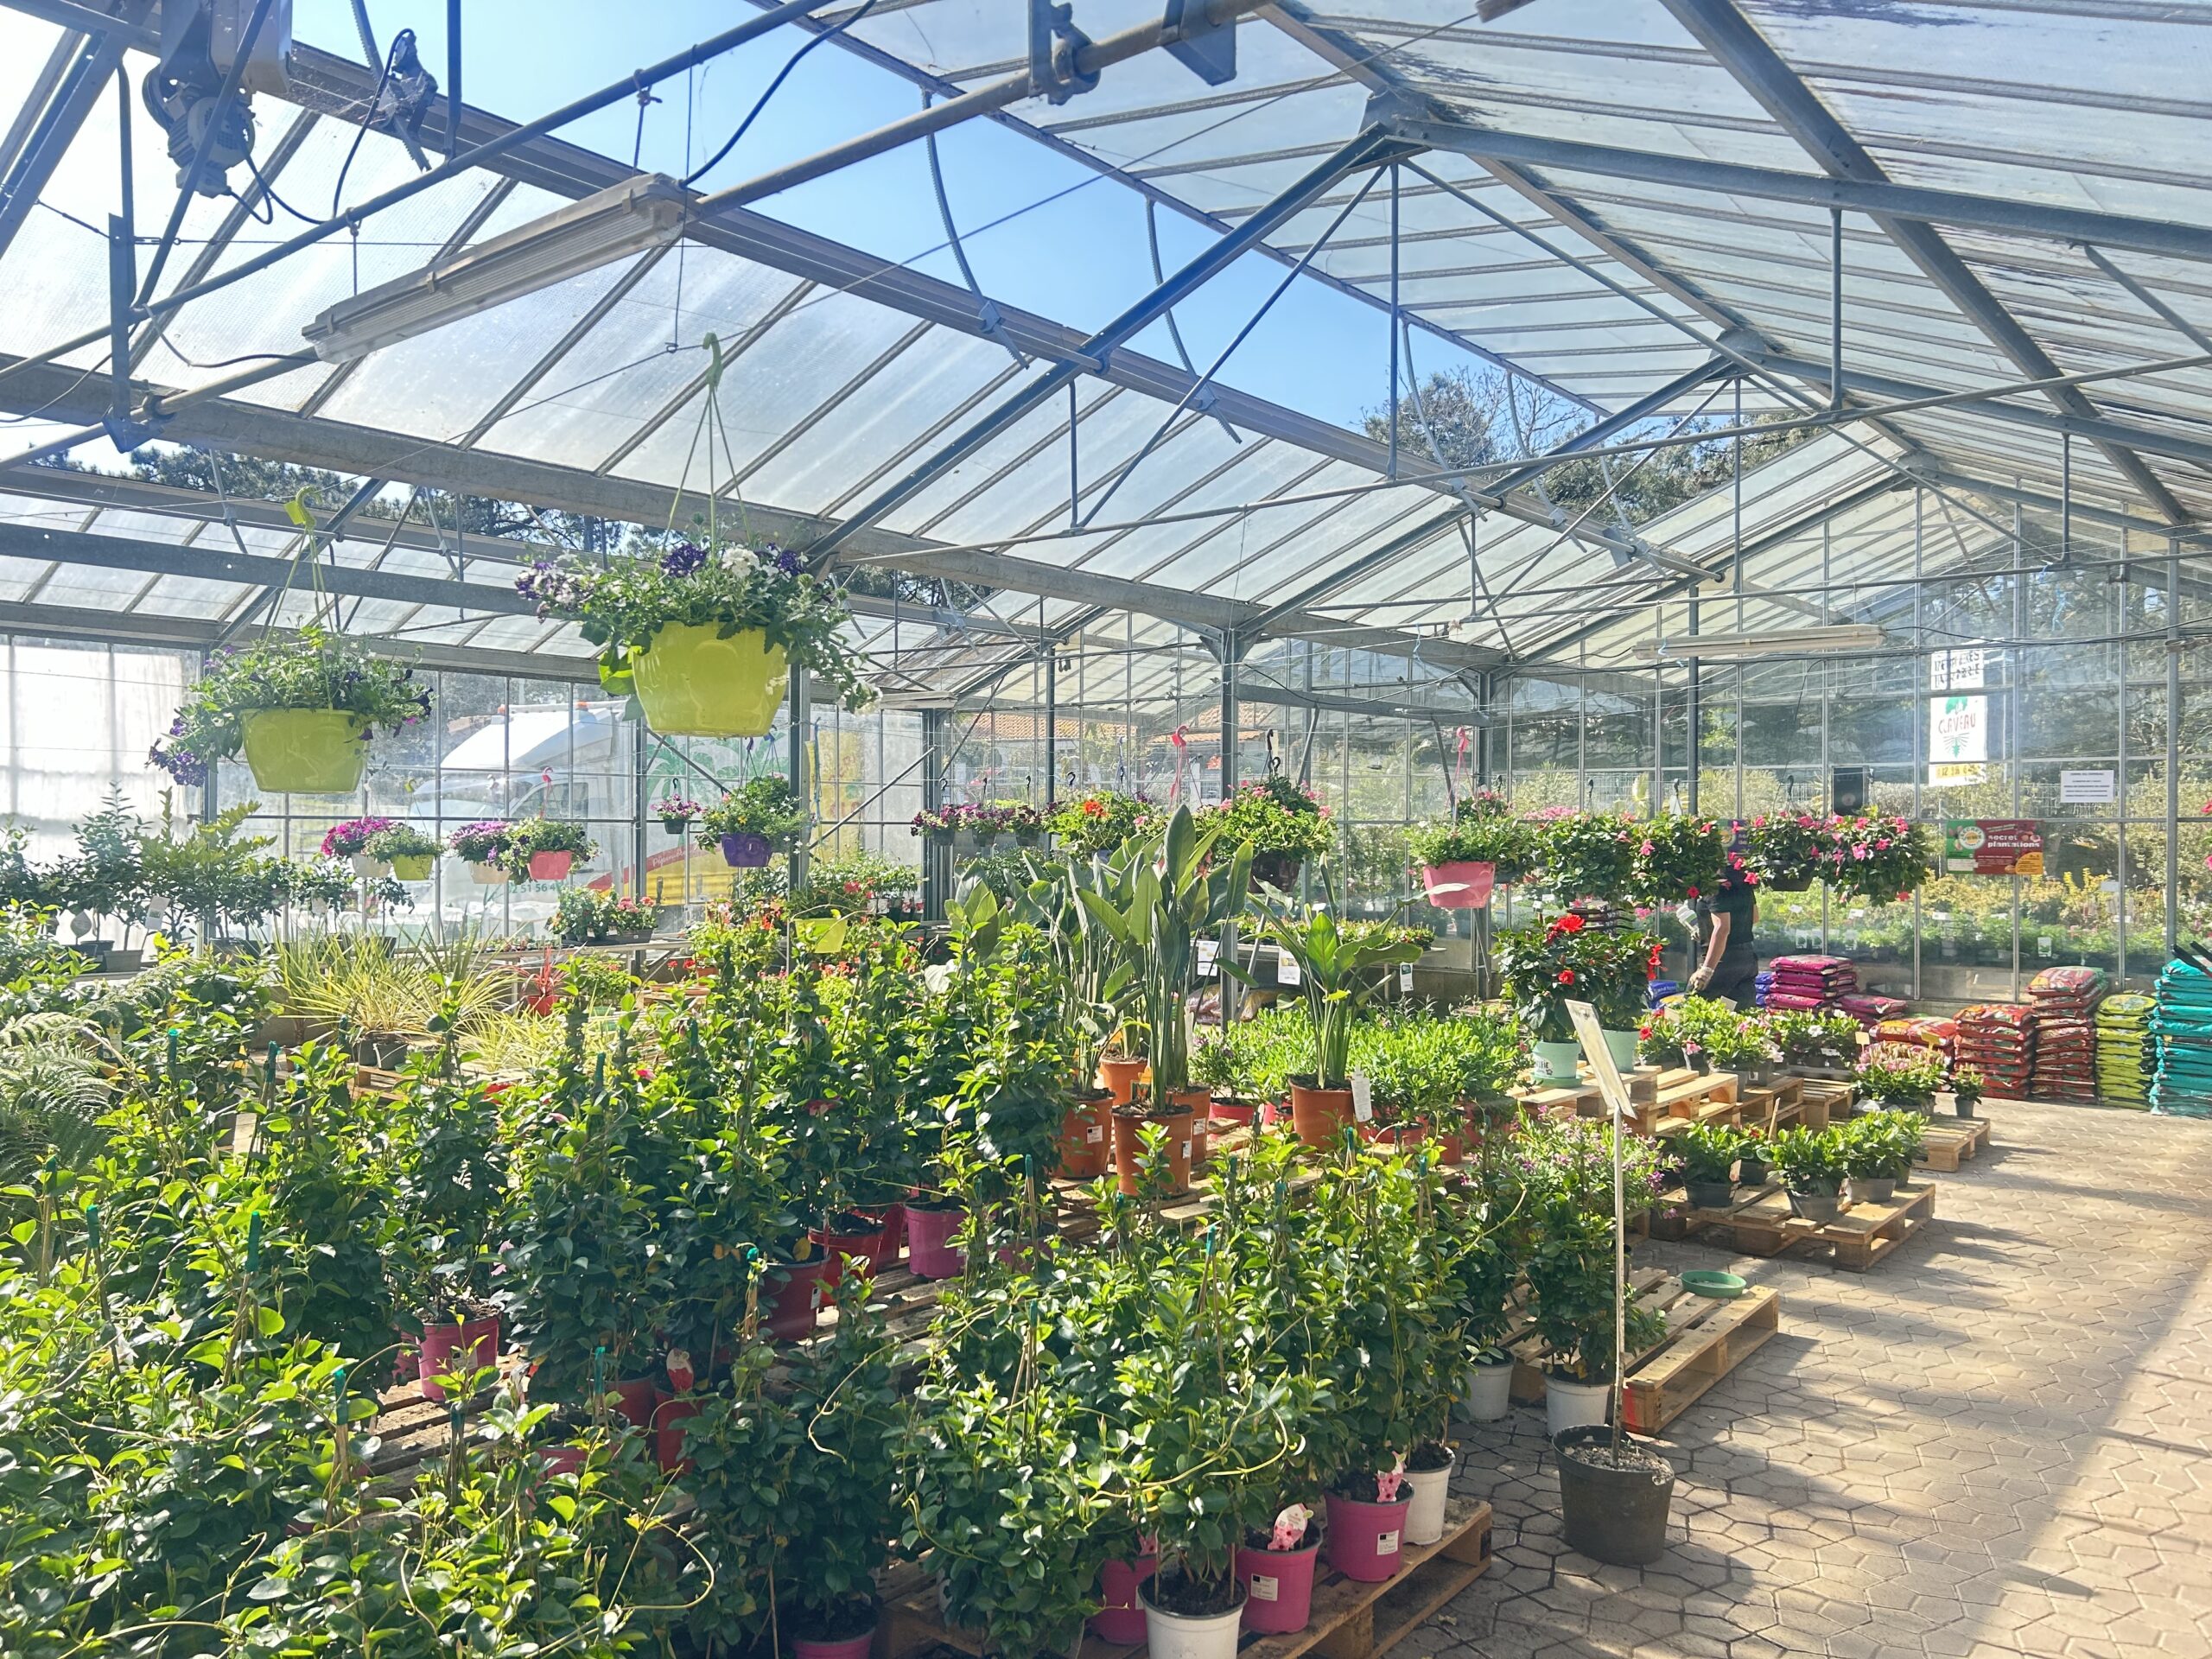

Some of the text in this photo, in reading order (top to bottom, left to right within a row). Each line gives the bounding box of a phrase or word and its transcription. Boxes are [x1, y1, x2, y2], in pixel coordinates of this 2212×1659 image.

[1938, 713, 1976, 734] CLAVEAU
[520, 884, 531, 893] 51
[536, 883, 548, 893] 56
